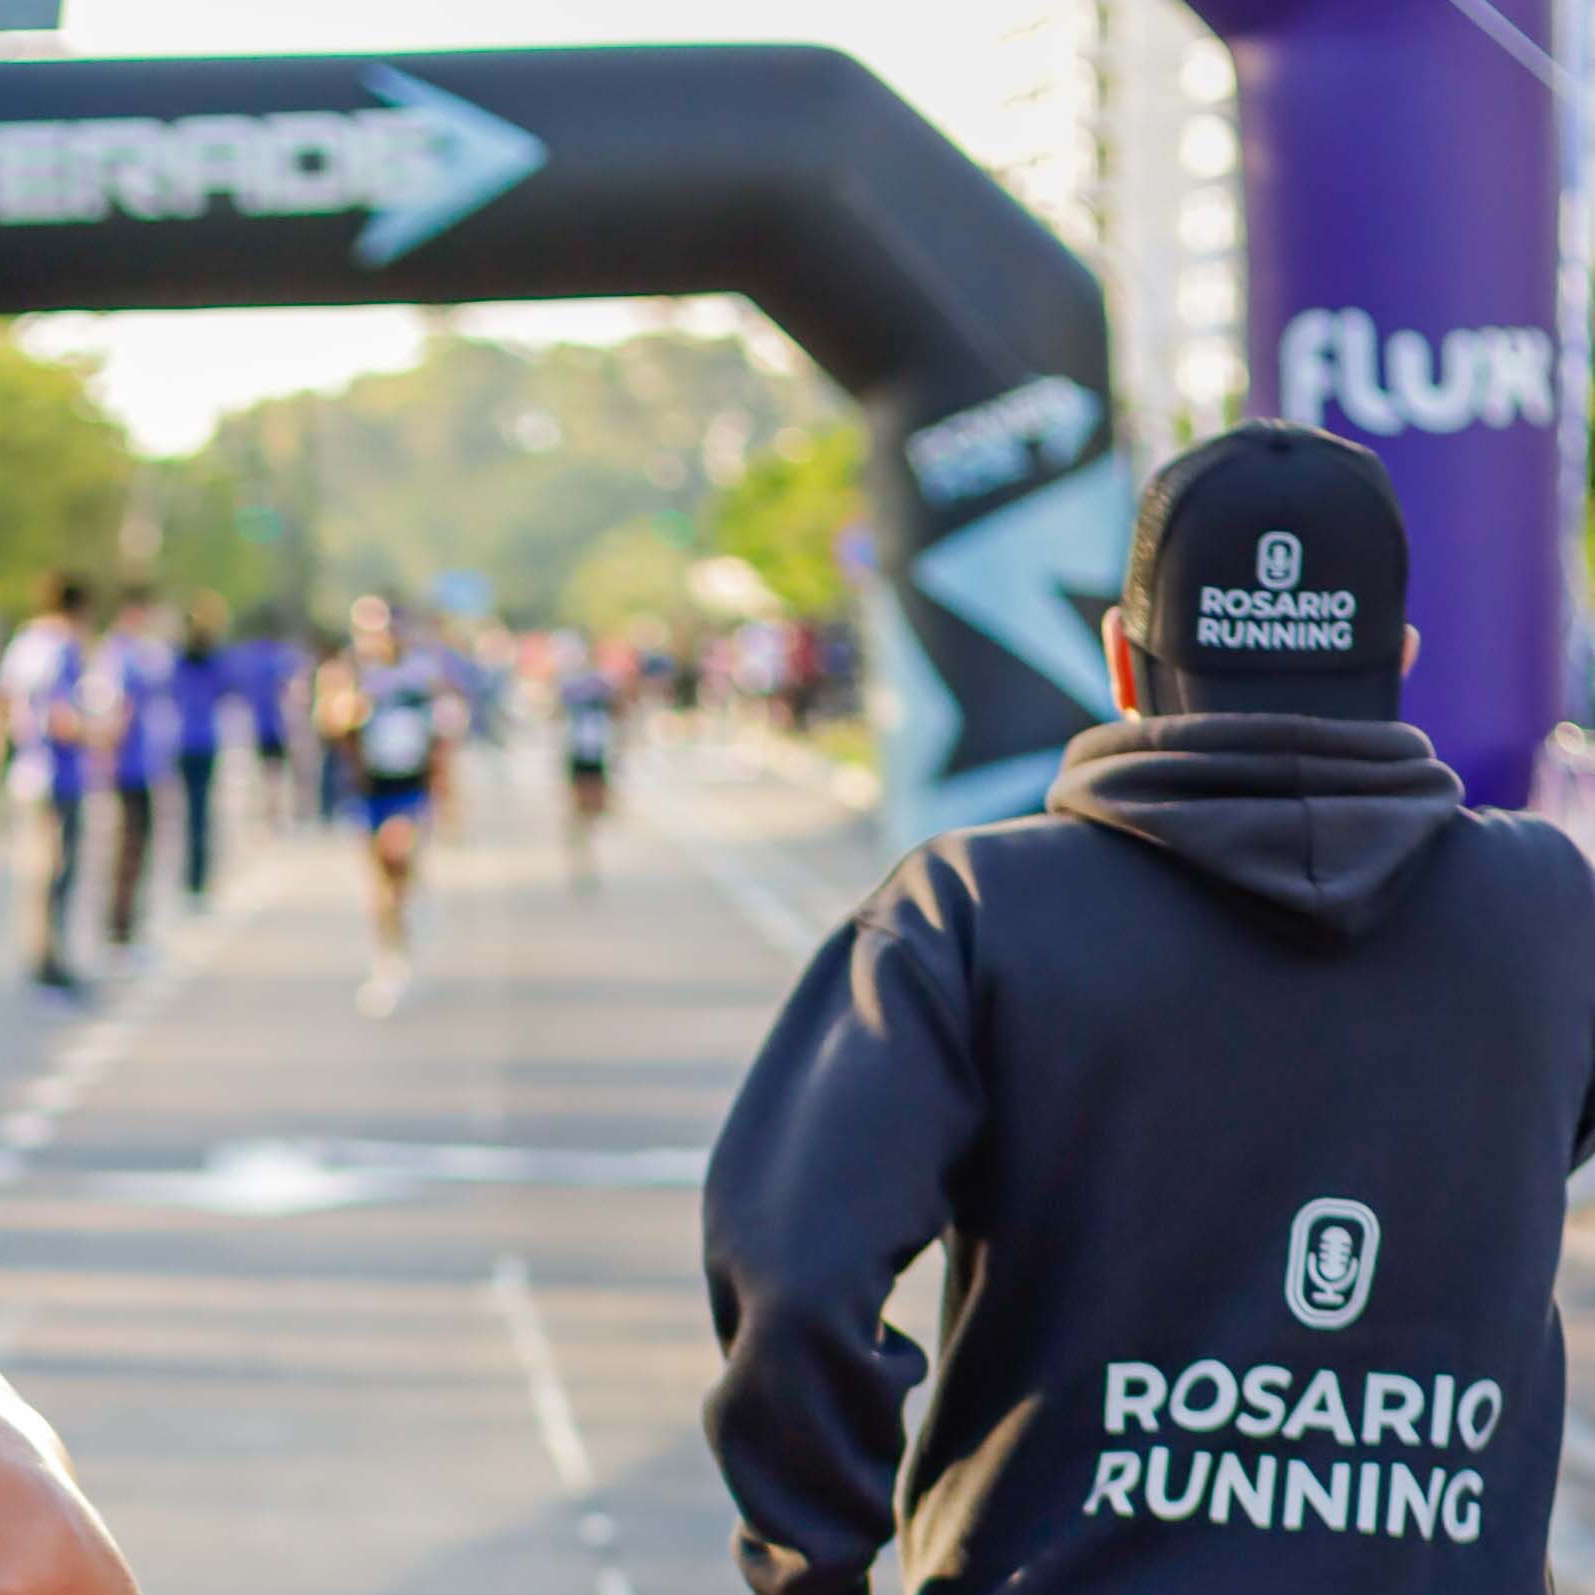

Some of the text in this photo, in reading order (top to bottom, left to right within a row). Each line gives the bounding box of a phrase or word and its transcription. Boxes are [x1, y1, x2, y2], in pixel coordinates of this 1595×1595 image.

[1197, 616, 1354, 651] RUNNING
[1200, 585, 1356, 621] ROSARIO
[1104, 1358, 1503, 1454] ROSARIO
[1082, 1446, 1484, 1545] RUNNING
